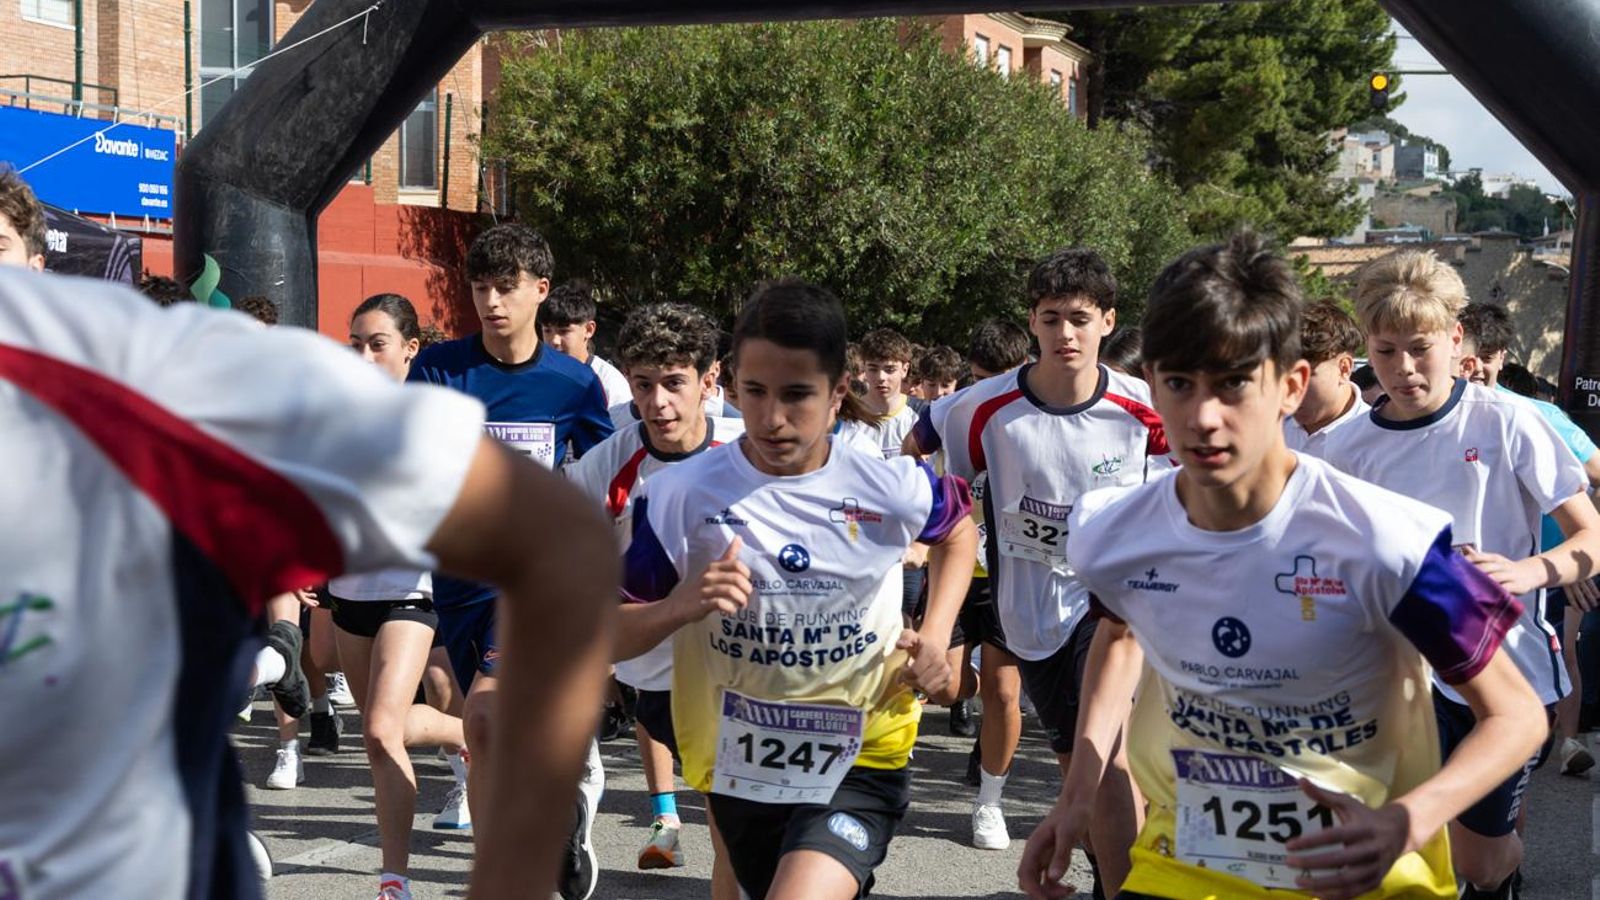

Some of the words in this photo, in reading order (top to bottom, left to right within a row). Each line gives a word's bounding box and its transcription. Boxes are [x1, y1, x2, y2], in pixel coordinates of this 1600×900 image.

[95, 132, 139, 157] Davante
[751, 579, 782, 590] ABLO
[786, 579, 843, 590] CARVAJAL
[765, 612, 787, 626] DE
[721, 619, 795, 645] SANTA
[710, 632, 743, 659] LOS
[749, 631, 877, 667] APÓSTOLES
[1180, 660, 1219, 677] PABLO
[1224, 666, 1300, 680] CARVAJAL
[1310, 706, 1356, 731] DE
[738, 733, 843, 775] 1247
[1203, 795, 1333, 844] 1251
